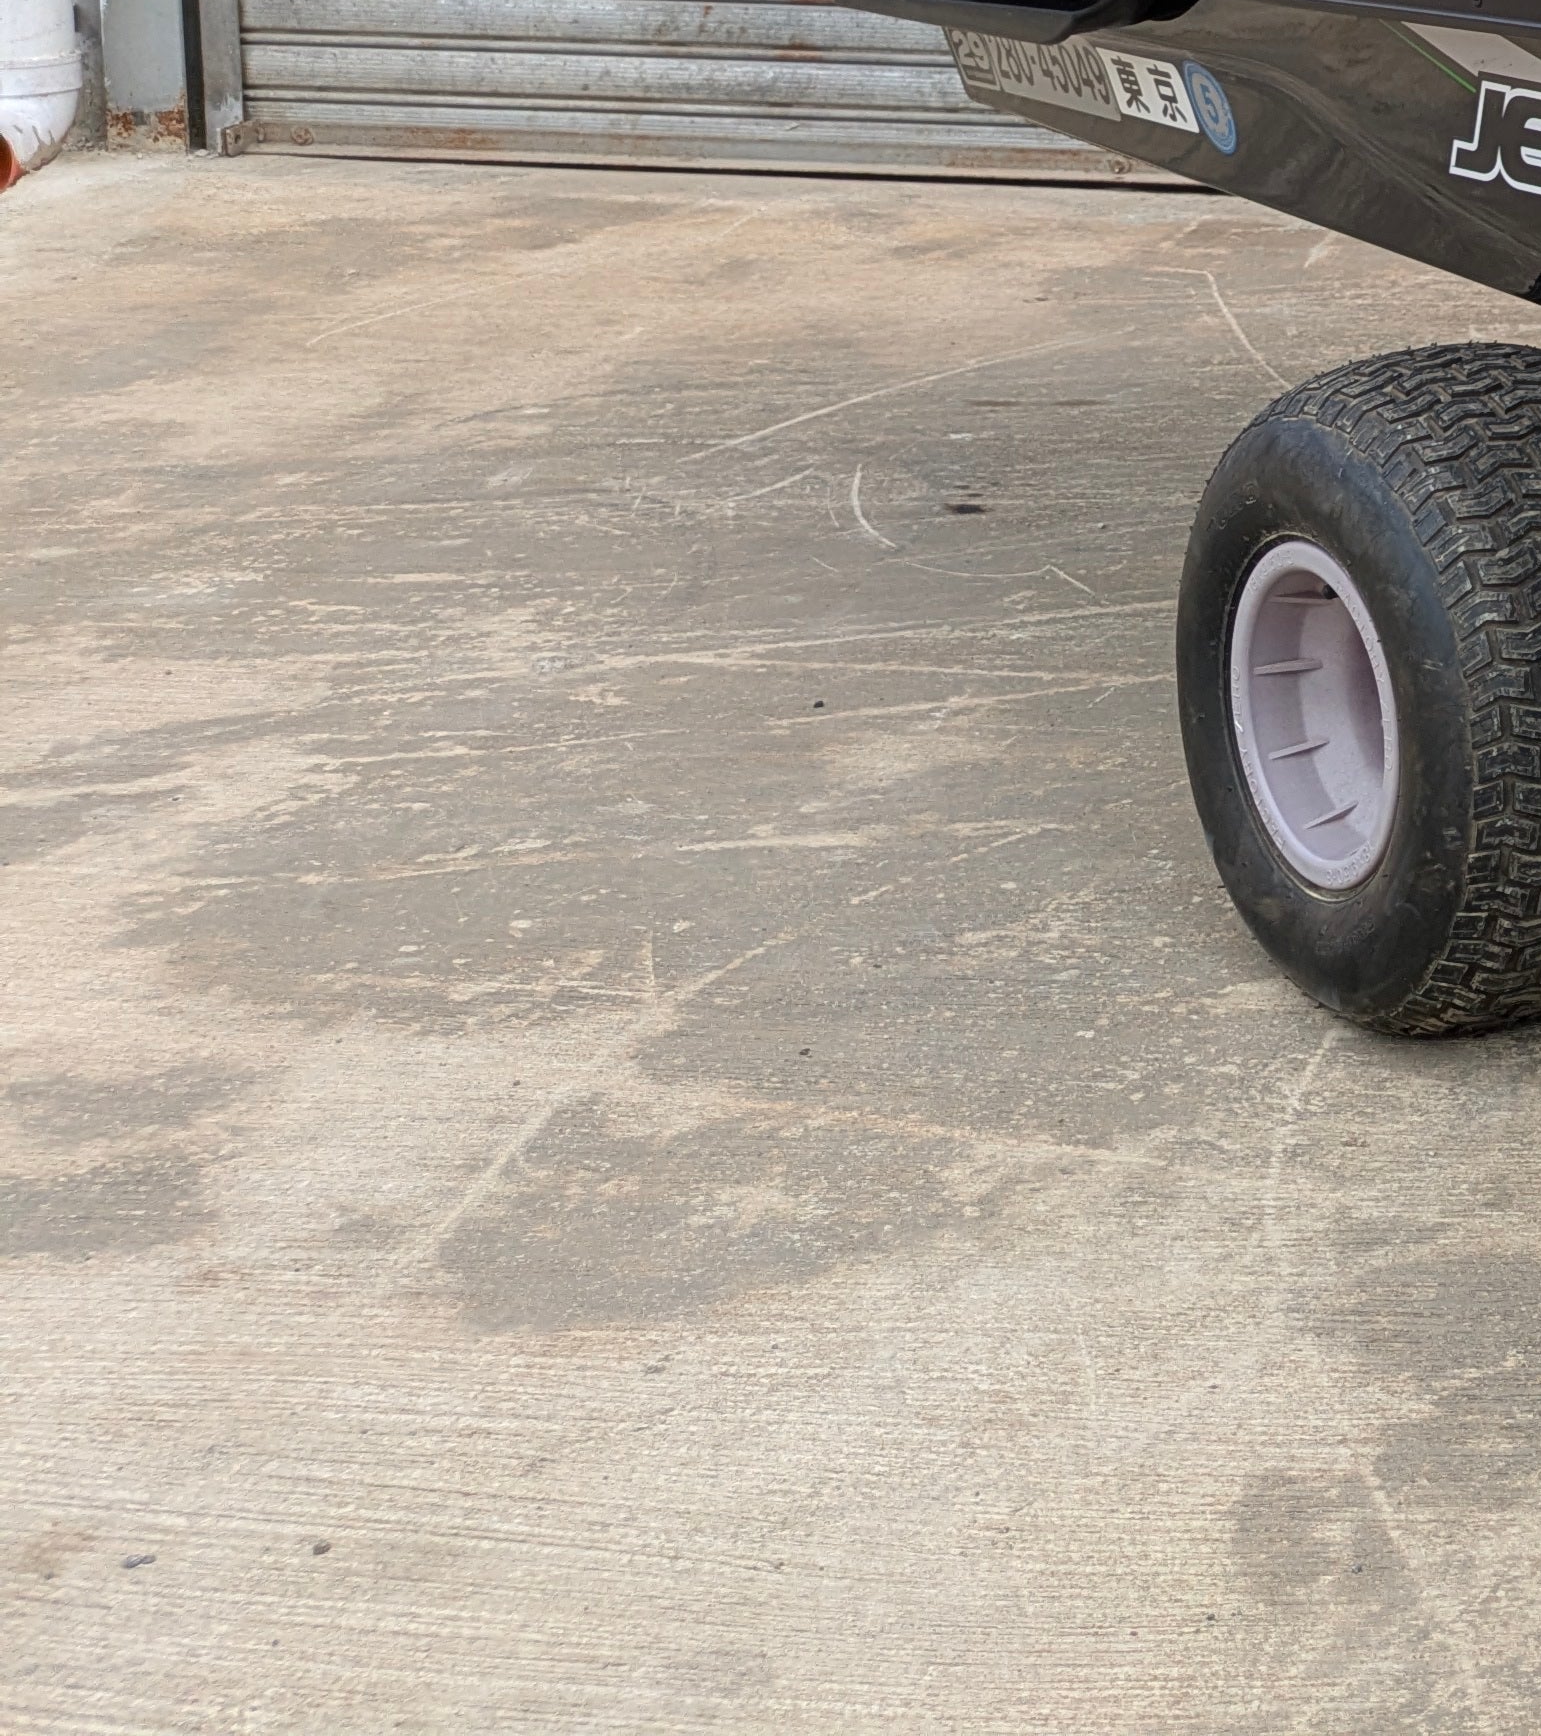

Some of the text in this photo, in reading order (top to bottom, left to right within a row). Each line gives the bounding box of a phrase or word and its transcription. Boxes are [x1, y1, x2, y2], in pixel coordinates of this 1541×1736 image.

[951, 30, 990, 70] 29
[1111, 57, 1188, 123] 東京
[1200, 84, 1219, 124] 5
